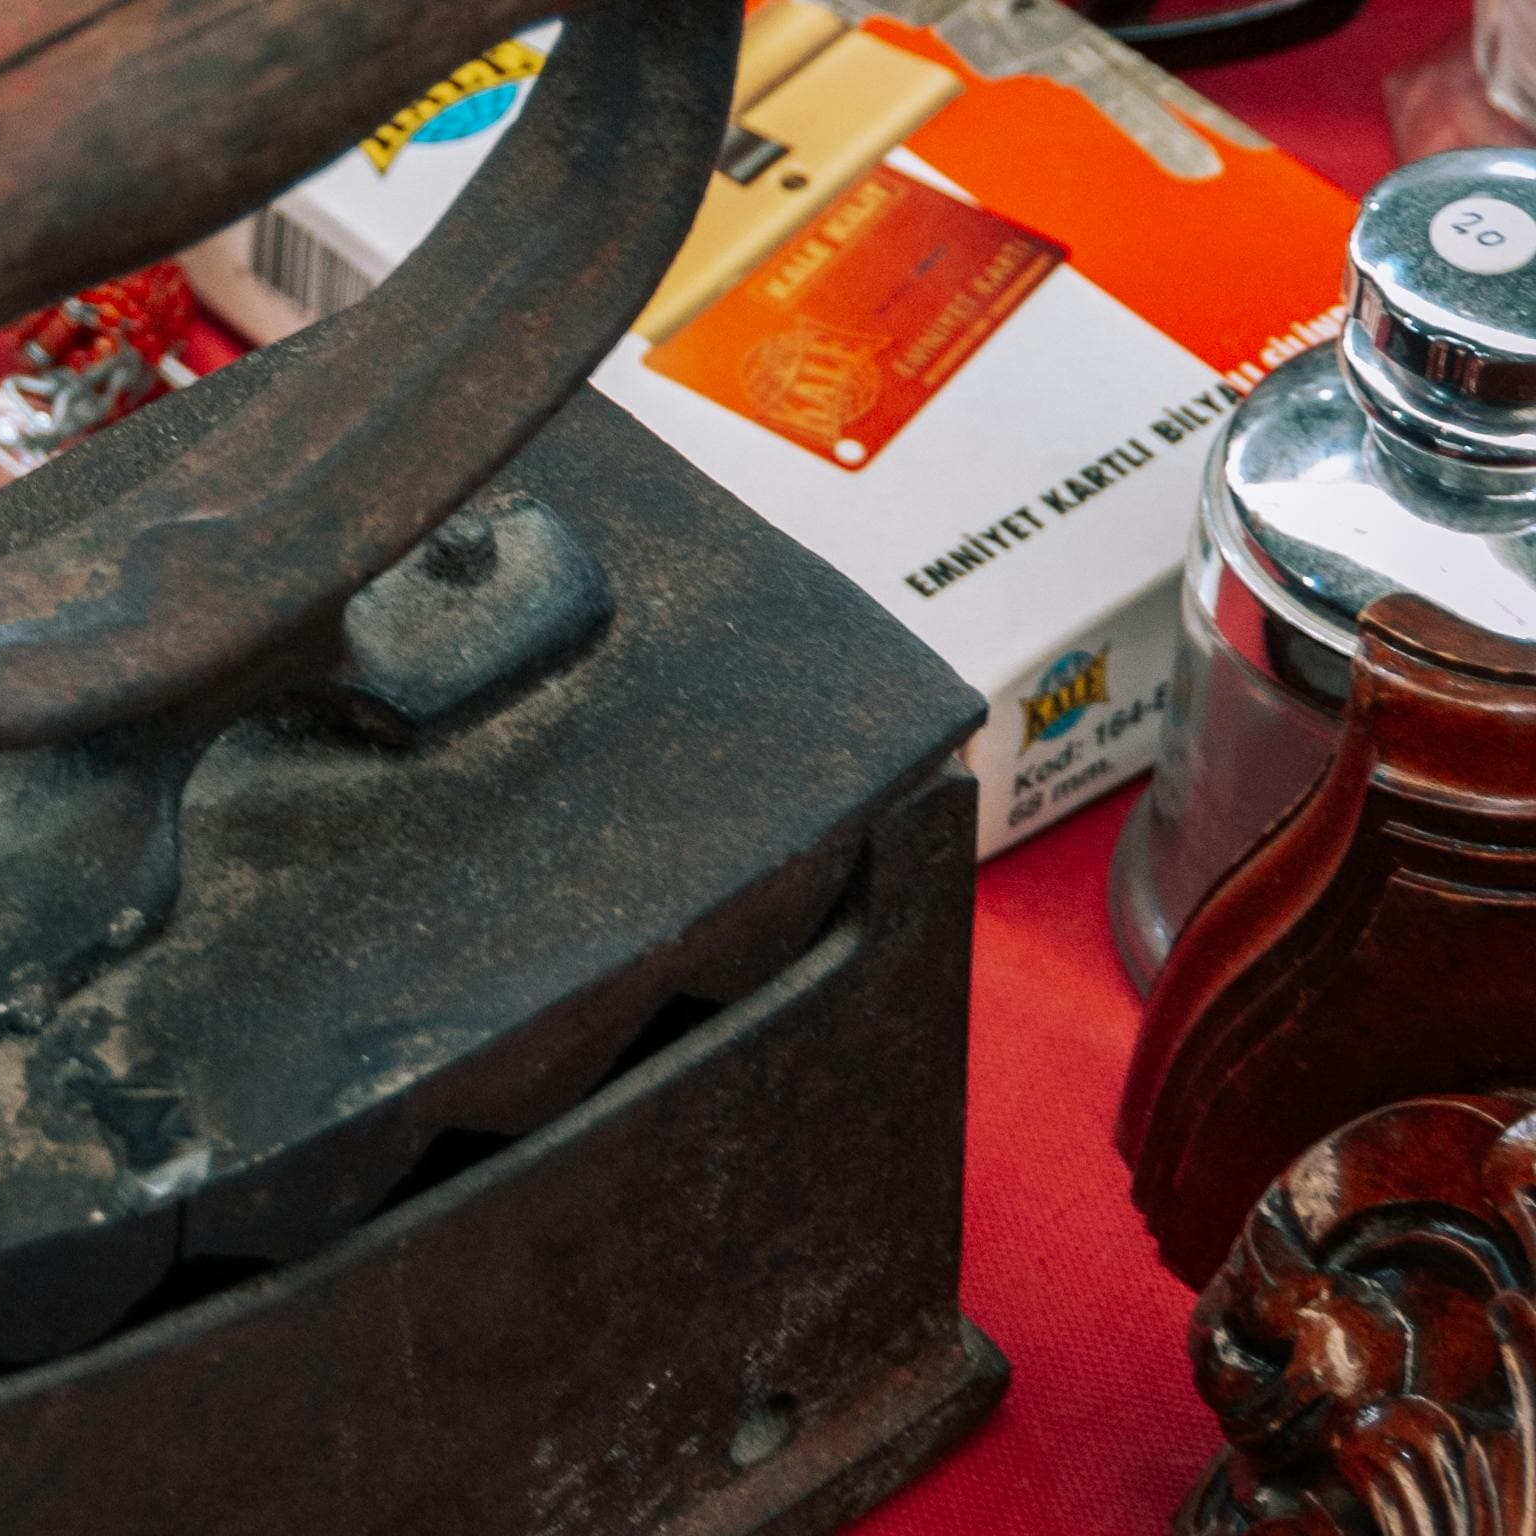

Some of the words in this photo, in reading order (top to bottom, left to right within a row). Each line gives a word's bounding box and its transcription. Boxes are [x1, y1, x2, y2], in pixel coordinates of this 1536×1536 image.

[1450, 211, 1506, 247] 20
[903, 505, 1046, 599] EMNİYET
[1039, 437, 1156, 517] KARTLI
[1013, 740, 1084, 795] Kod:
